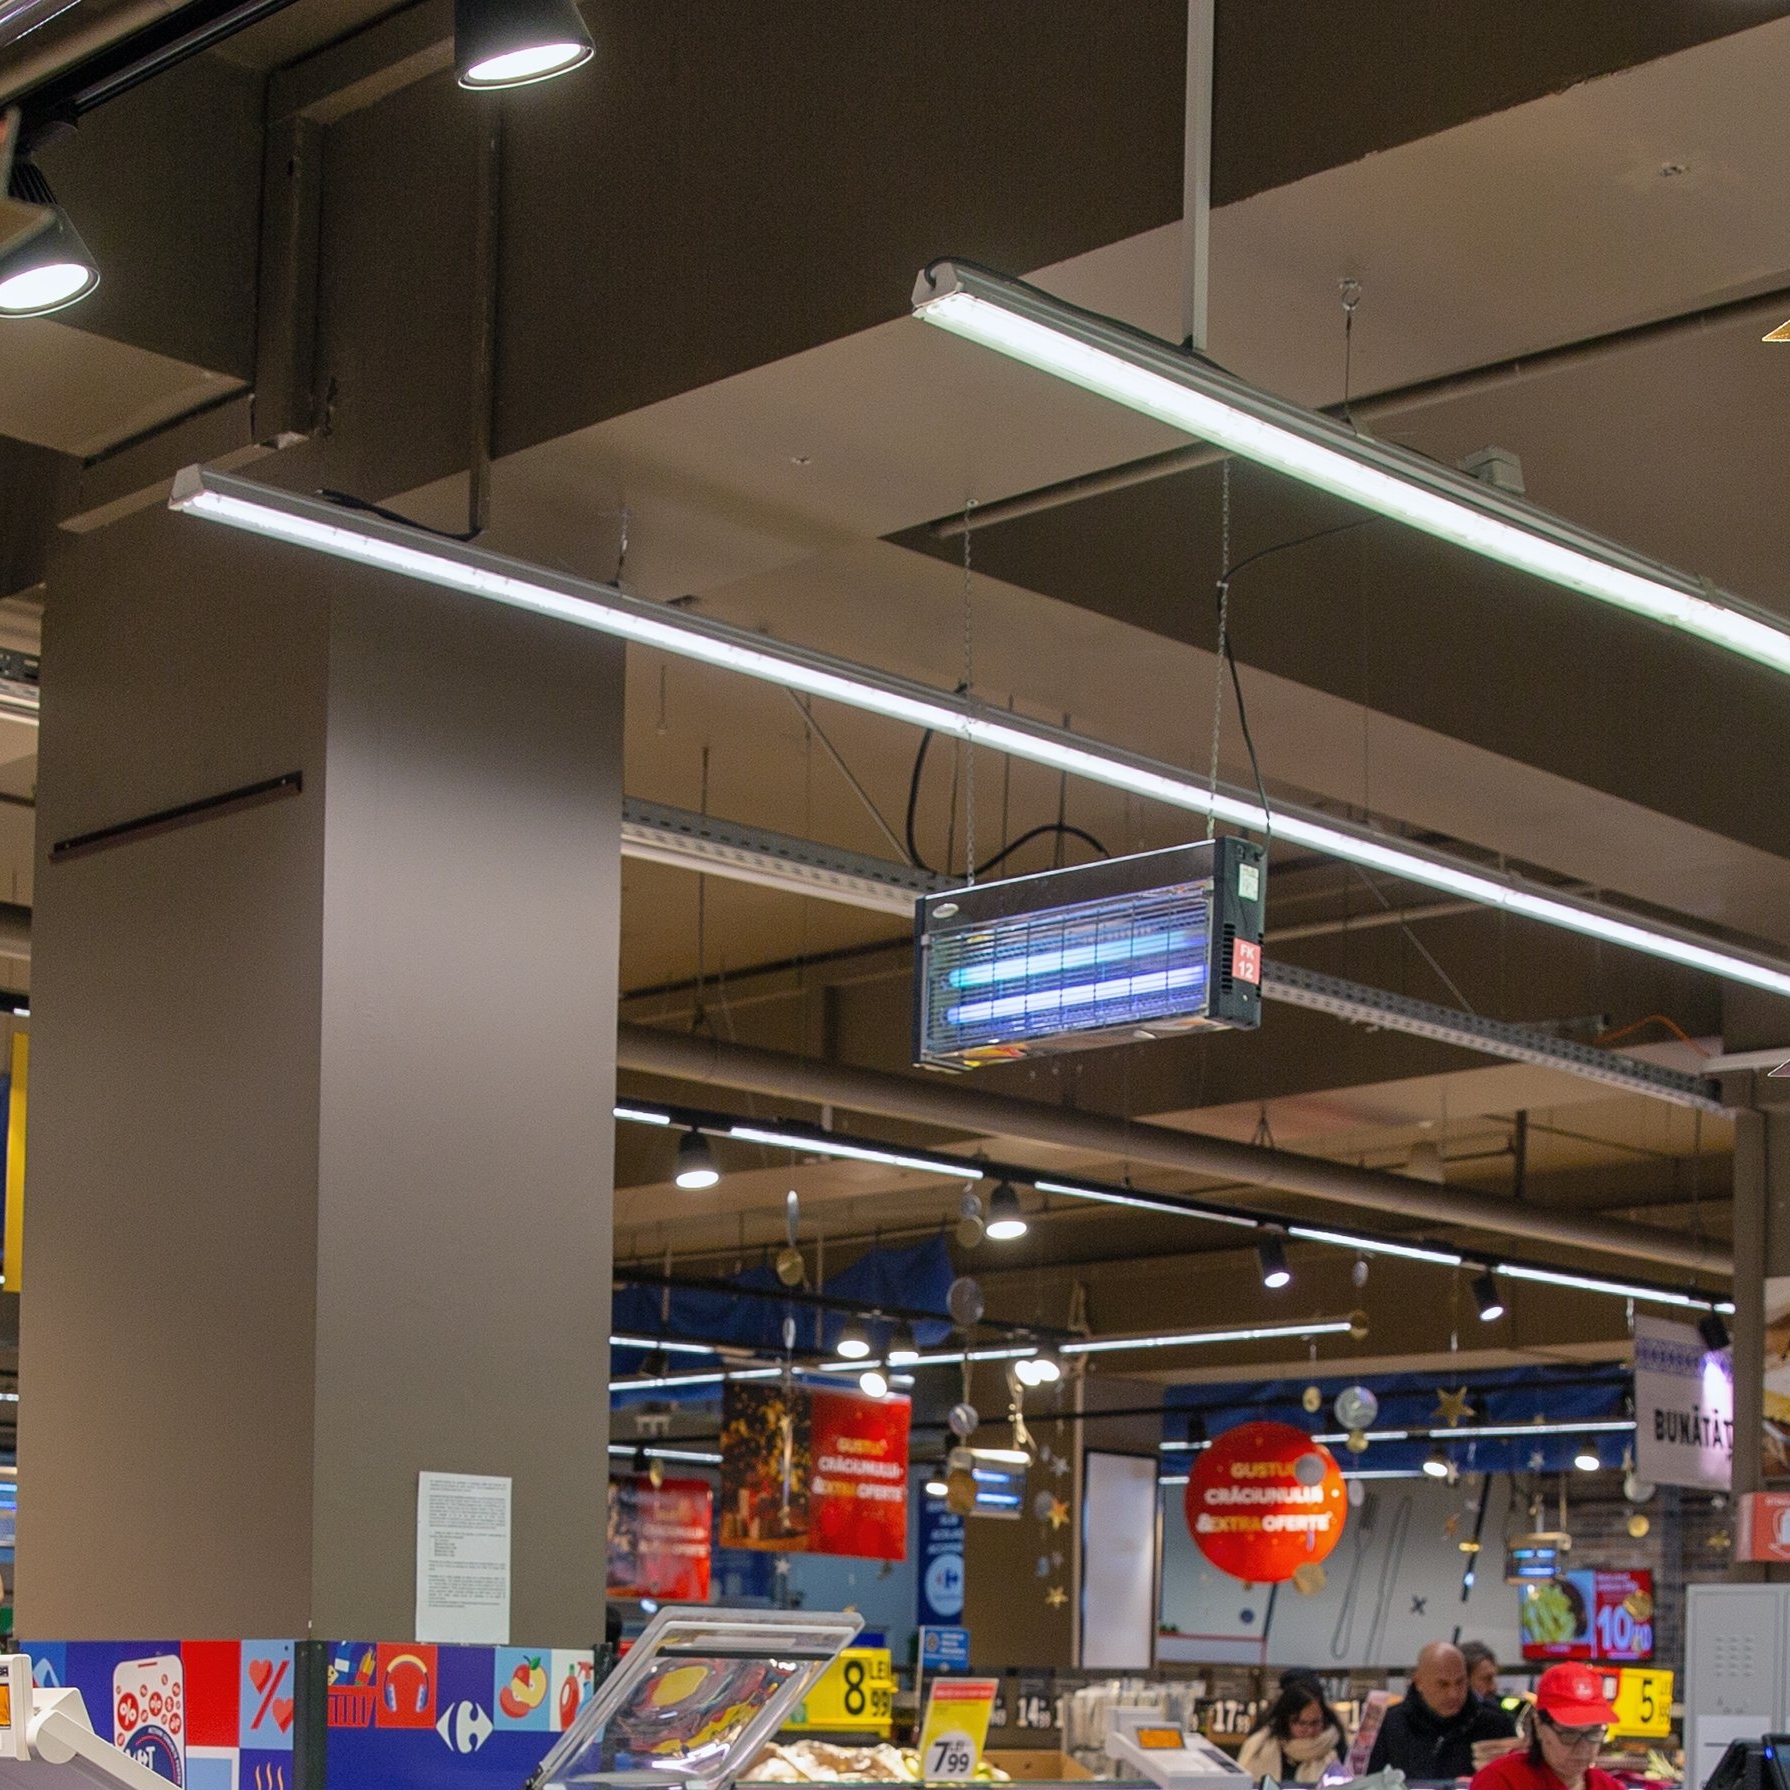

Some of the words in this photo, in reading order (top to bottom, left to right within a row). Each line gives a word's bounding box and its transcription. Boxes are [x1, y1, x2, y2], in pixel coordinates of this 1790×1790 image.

[843, 1659, 867, 1716] 8
[932, 1741, 951, 1773] 7
[948, 1753, 970, 1773] 99
